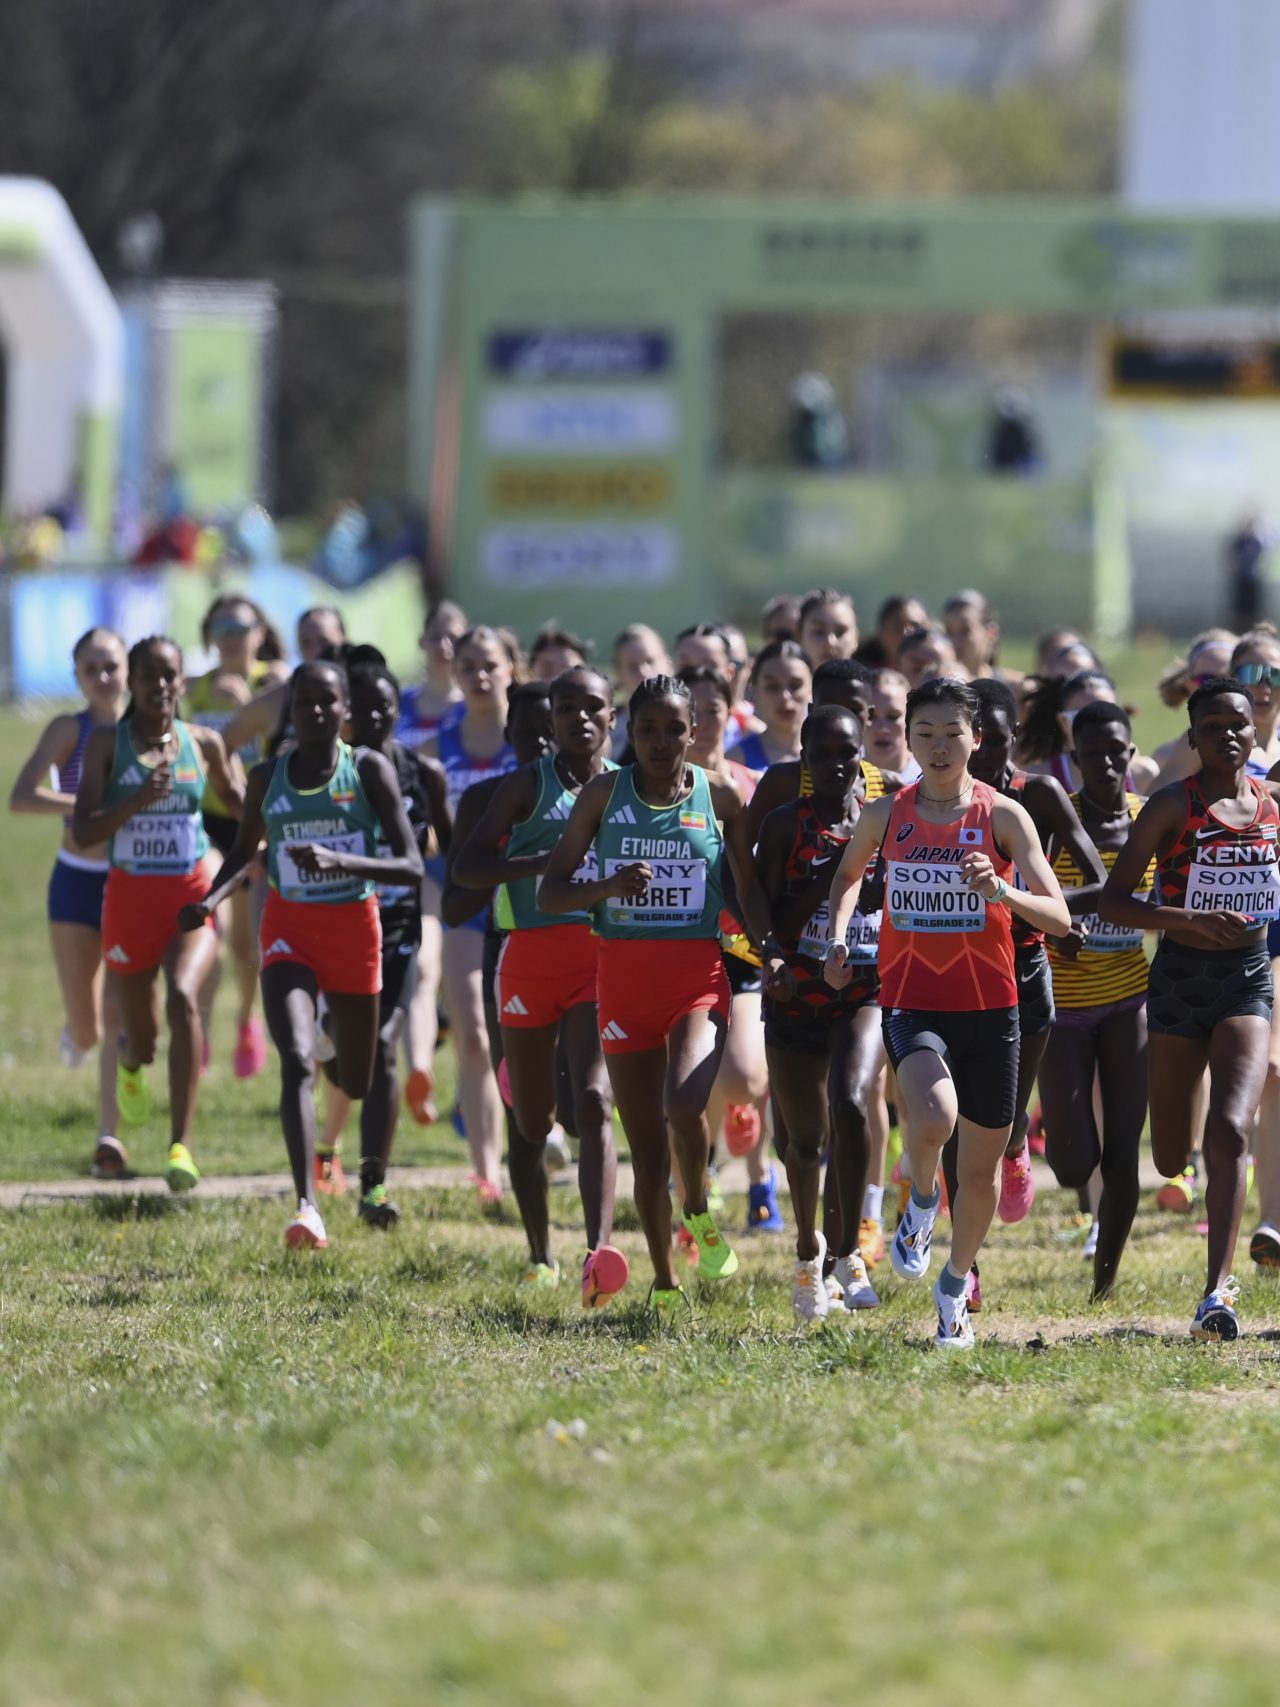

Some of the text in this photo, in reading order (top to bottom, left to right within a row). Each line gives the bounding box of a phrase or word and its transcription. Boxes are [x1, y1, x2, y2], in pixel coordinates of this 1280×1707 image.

[282, 818, 348, 840] ETHIOPIA
[133, 839, 178, 856] DIDA
[621, 837, 692, 859] ETHIOPIA
[905, 846, 966, 862] JAPAN
[1195, 844, 1276, 864] KENYA
[1198, 870, 1273, 886] SONY
[620, 887, 692, 907] NBRET
[891, 889, 980, 913] OKUMOTO
[634, 913, 698, 921] BELGRADE 24
[913, 918, 981, 928] BELGRADE 24
[806, 921, 821, 939] M.
